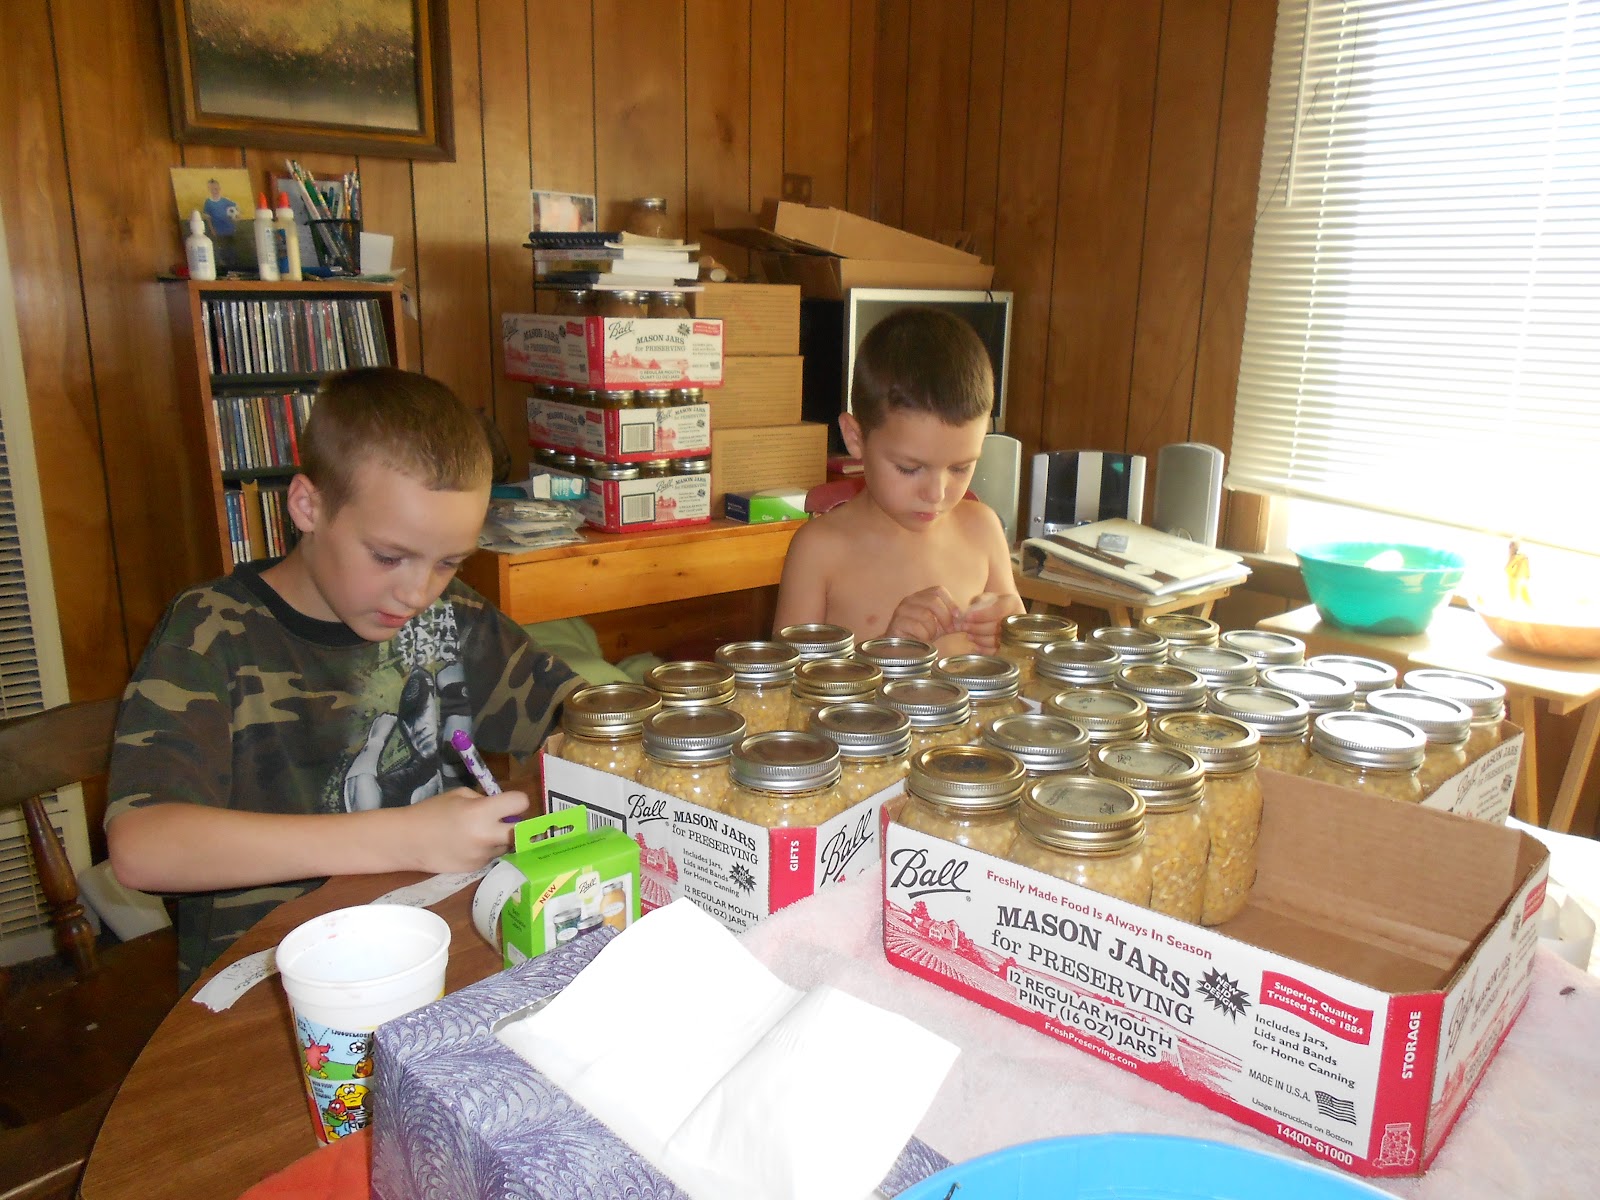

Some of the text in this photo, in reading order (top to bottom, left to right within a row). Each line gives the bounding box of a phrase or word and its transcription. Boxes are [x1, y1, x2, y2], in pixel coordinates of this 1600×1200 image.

[608, 321, 635, 340] Ball
[636, 335, 685, 345] MASON JARS
[627, 794, 669, 825] Ball
[672, 823, 759, 865] for PRESERVING
[673, 810, 756, 851] MASON JARS
[820, 807, 874, 888] Ball
[683, 848, 723, 871] Includes Jars,
[683, 858, 696, 869] Lids
[696, 865, 709, 875] and
[709, 868, 729, 882] Bands
[789, 840, 800, 872] GIFTS
[890, 848, 971, 899] Ball
[539, 884, 557, 905] NEW
[683, 868, 740, 898] for Home Canning
[684, 884, 759, 921] 12 REGULAR MOUTH
[713, 908, 728, 921] OZ)
[728, 912, 747, 927] JARS
[986, 869, 1212, 960] Freshly Made Food Is Always In Season
[997, 905, 1190, 999] MASON JARS
[990, 929, 1194, 1025] for PRESERVING
[1215, 975, 1239, 995] NEW
[1215, 983, 1231, 997] LID
[1009, 970, 1172, 1049] 12 REGULAR MOUTH
[1203, 983, 1237, 1012] DESIGN
[1267, 989, 1364, 1036] Trusted Since 1884
[1274, 981, 1359, 1024] Superior Quality
[1019, 989, 1157, 1058] PINT (16 OZ) JARS
[1255, 1014, 1328, 1050] Includes Jars,
[1044, 1021, 1137, 1069] FreshPreserving.com
[1252, 1039, 1356, 1089] for Home Canning
[1254, 1026, 1338, 1066] Lids and Bands
[1401, 1011, 1422, 1079] STORAGE
[1248, 1069, 1311, 1102] MADE IN U.S.A.
[1252, 1097, 1272, 1112] Usage
[1273, 1105, 1313, 1127] Instructions
[1325, 1129, 1353, 1146] Bottom
[1275, 1124, 1353, 1165] 14400-61000
